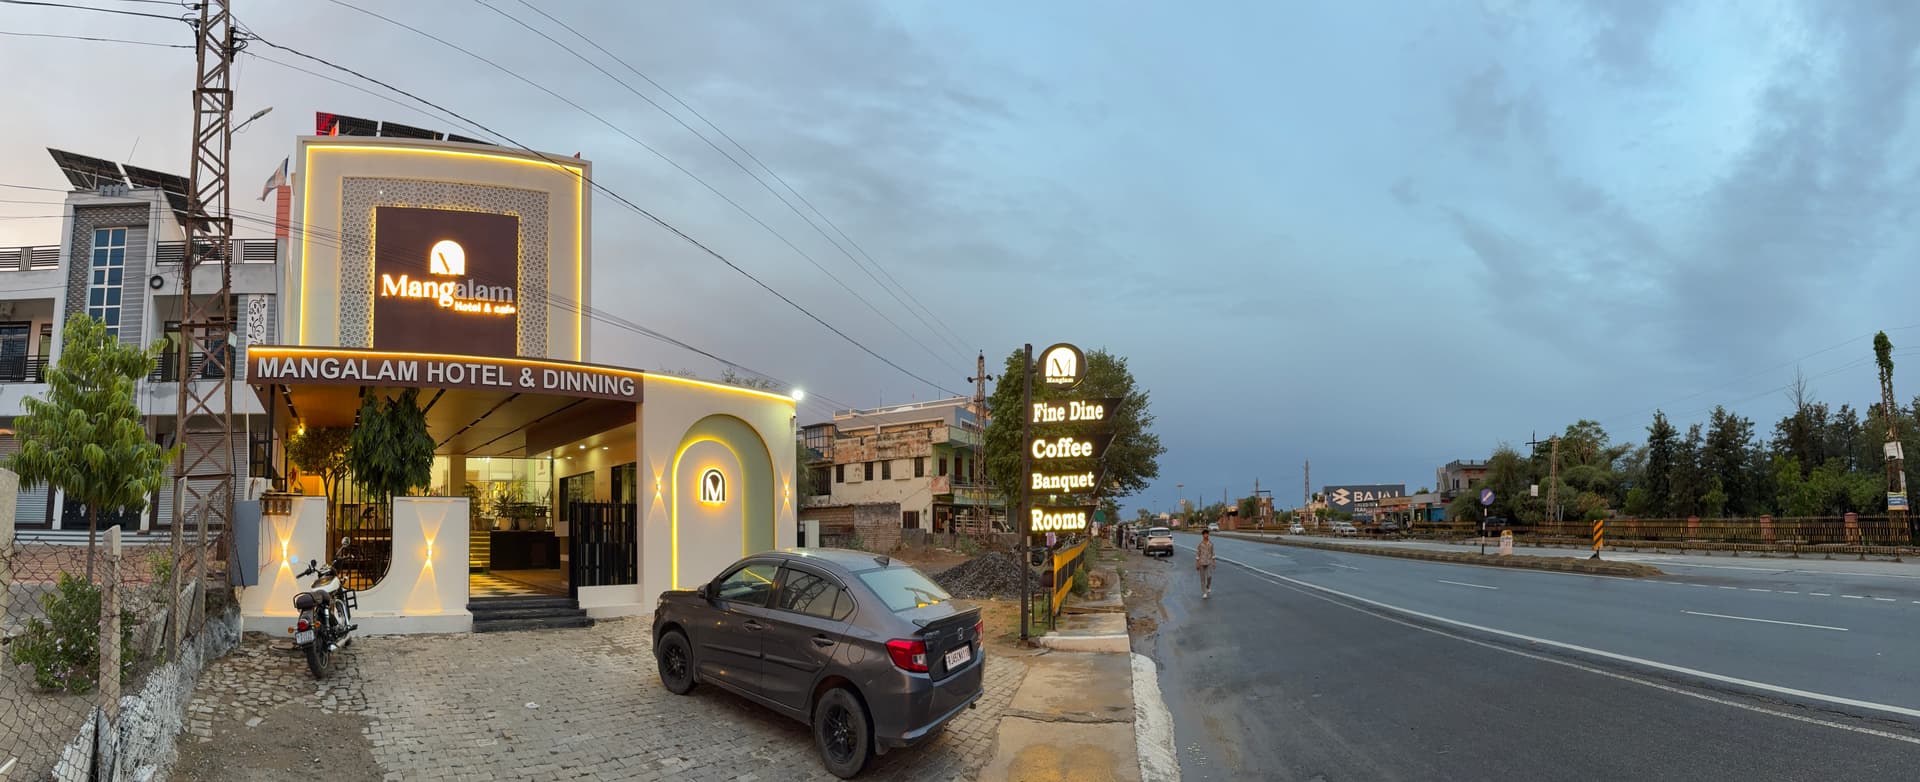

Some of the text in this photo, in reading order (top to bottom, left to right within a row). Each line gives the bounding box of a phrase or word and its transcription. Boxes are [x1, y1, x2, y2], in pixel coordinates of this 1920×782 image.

[381, 274, 513, 307] Mangalam
[455, 301, 482, 313] Hotel
[257, 357, 635, 396] MANGALAM HOTEL & DINNING
[1033, 400, 1103, 423] Fine Dine
[1032, 437, 1093, 459] Coffee
[1032, 471, 1095, 492] Banquet
[1031, 509, 1086, 531] Rooms
